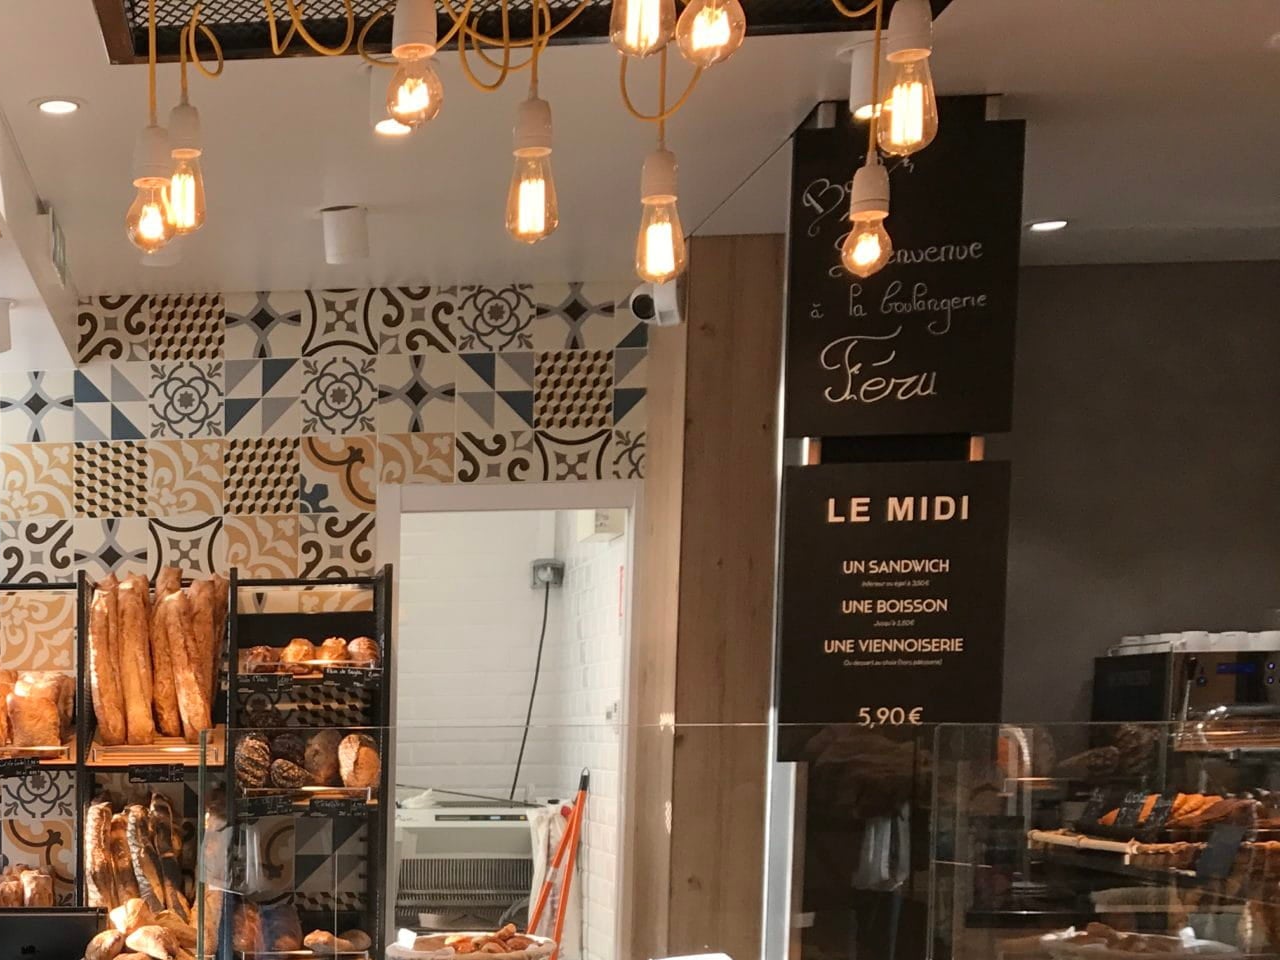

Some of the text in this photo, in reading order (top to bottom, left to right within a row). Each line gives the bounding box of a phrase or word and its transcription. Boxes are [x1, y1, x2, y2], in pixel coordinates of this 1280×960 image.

[848, 282, 867, 318] la
[879, 280, 988, 335] boulangerie
[827, 495, 969, 523] LE MIDI
[842, 559, 950, 574] UN SANDWICH
[842, 598, 948, 614] UNE BOISSON
[824, 638, 964, 653] UNE VIENNOISERIE
